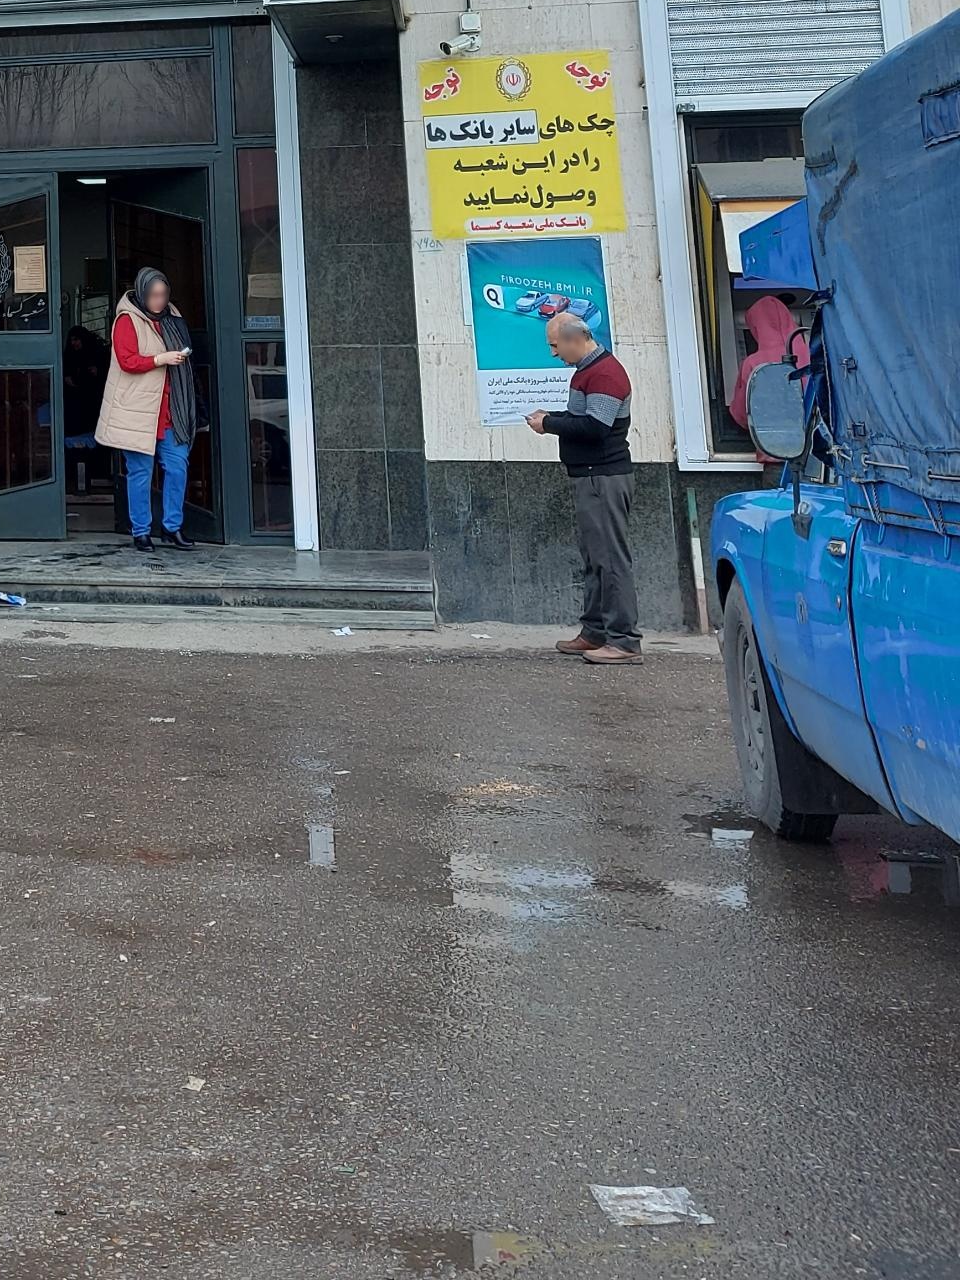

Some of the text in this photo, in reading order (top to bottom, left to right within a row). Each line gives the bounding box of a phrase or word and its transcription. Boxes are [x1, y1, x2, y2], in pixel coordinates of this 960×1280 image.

[424, 67, 461, 102] توجه
[565, 61, 610, 91] توجه
[499, 118, 536, 142] سایر
[453, 147, 601, 176] را در این شعبه
[463, 184, 597, 211] وصول نمایید
[503, 219, 534, 232] شعبه
[535, 218, 554, 231] ملی
[556, 216, 586, 229] بانک
[501, 274, 593, 296] FIROOZEH.BMI.IR
